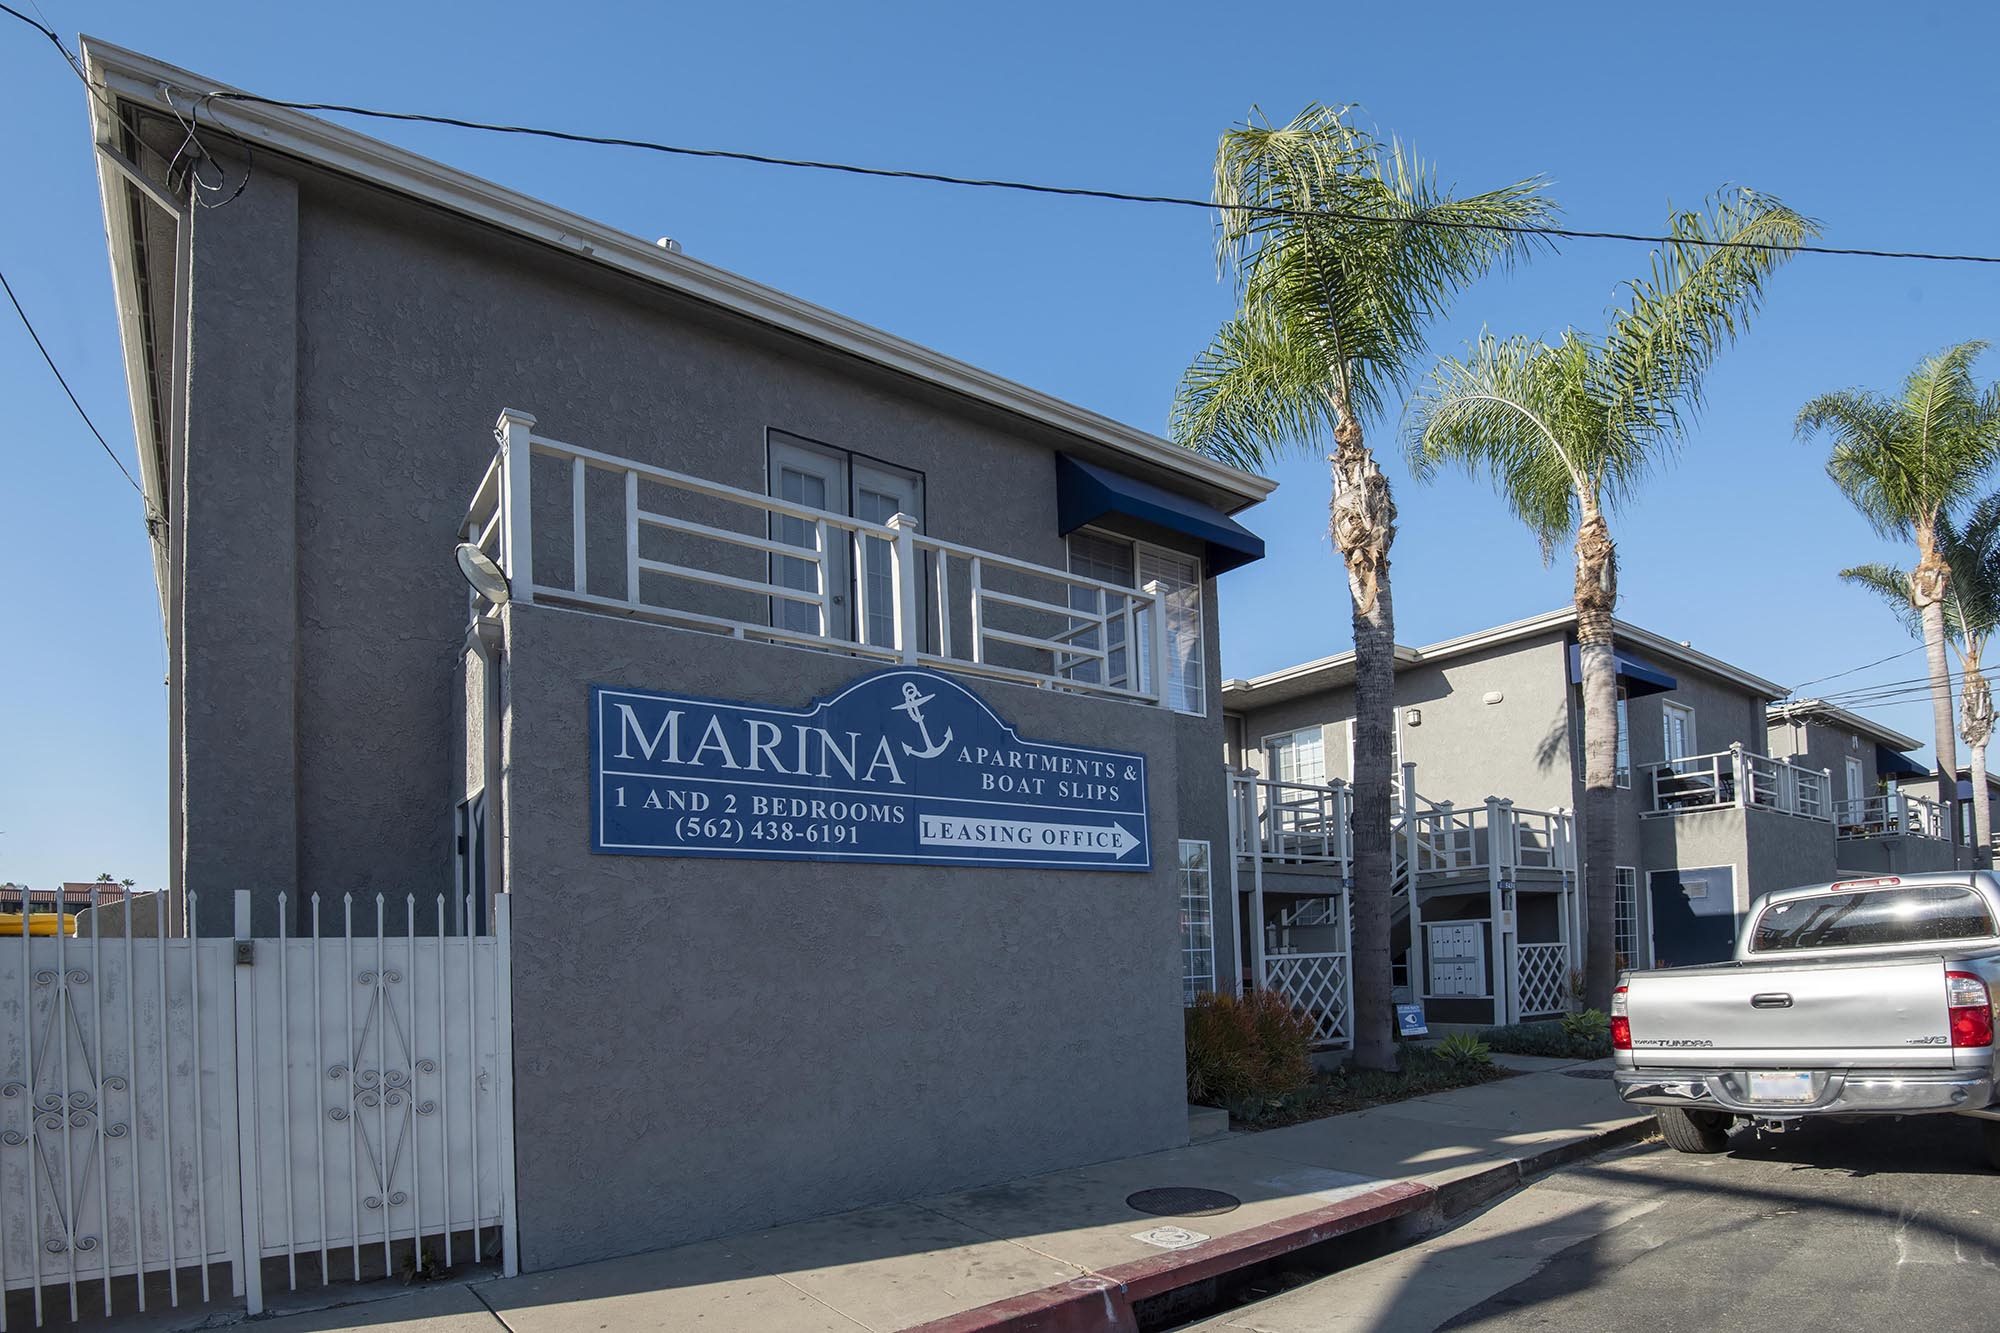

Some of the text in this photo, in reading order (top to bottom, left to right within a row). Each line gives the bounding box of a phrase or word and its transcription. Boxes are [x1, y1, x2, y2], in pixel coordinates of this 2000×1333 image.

[613, 703, 906, 785] MARINA
[957, 746, 1137, 781] APARTMENTS &
[981, 773, 1119, 801] BOAT SLIPS
[615, 787, 904, 823] 1 AND 2 BEDROOMS
[675, 816, 858, 844] (562) 438-6191
[921, 820, 1123, 848] LEASING OFFICE
